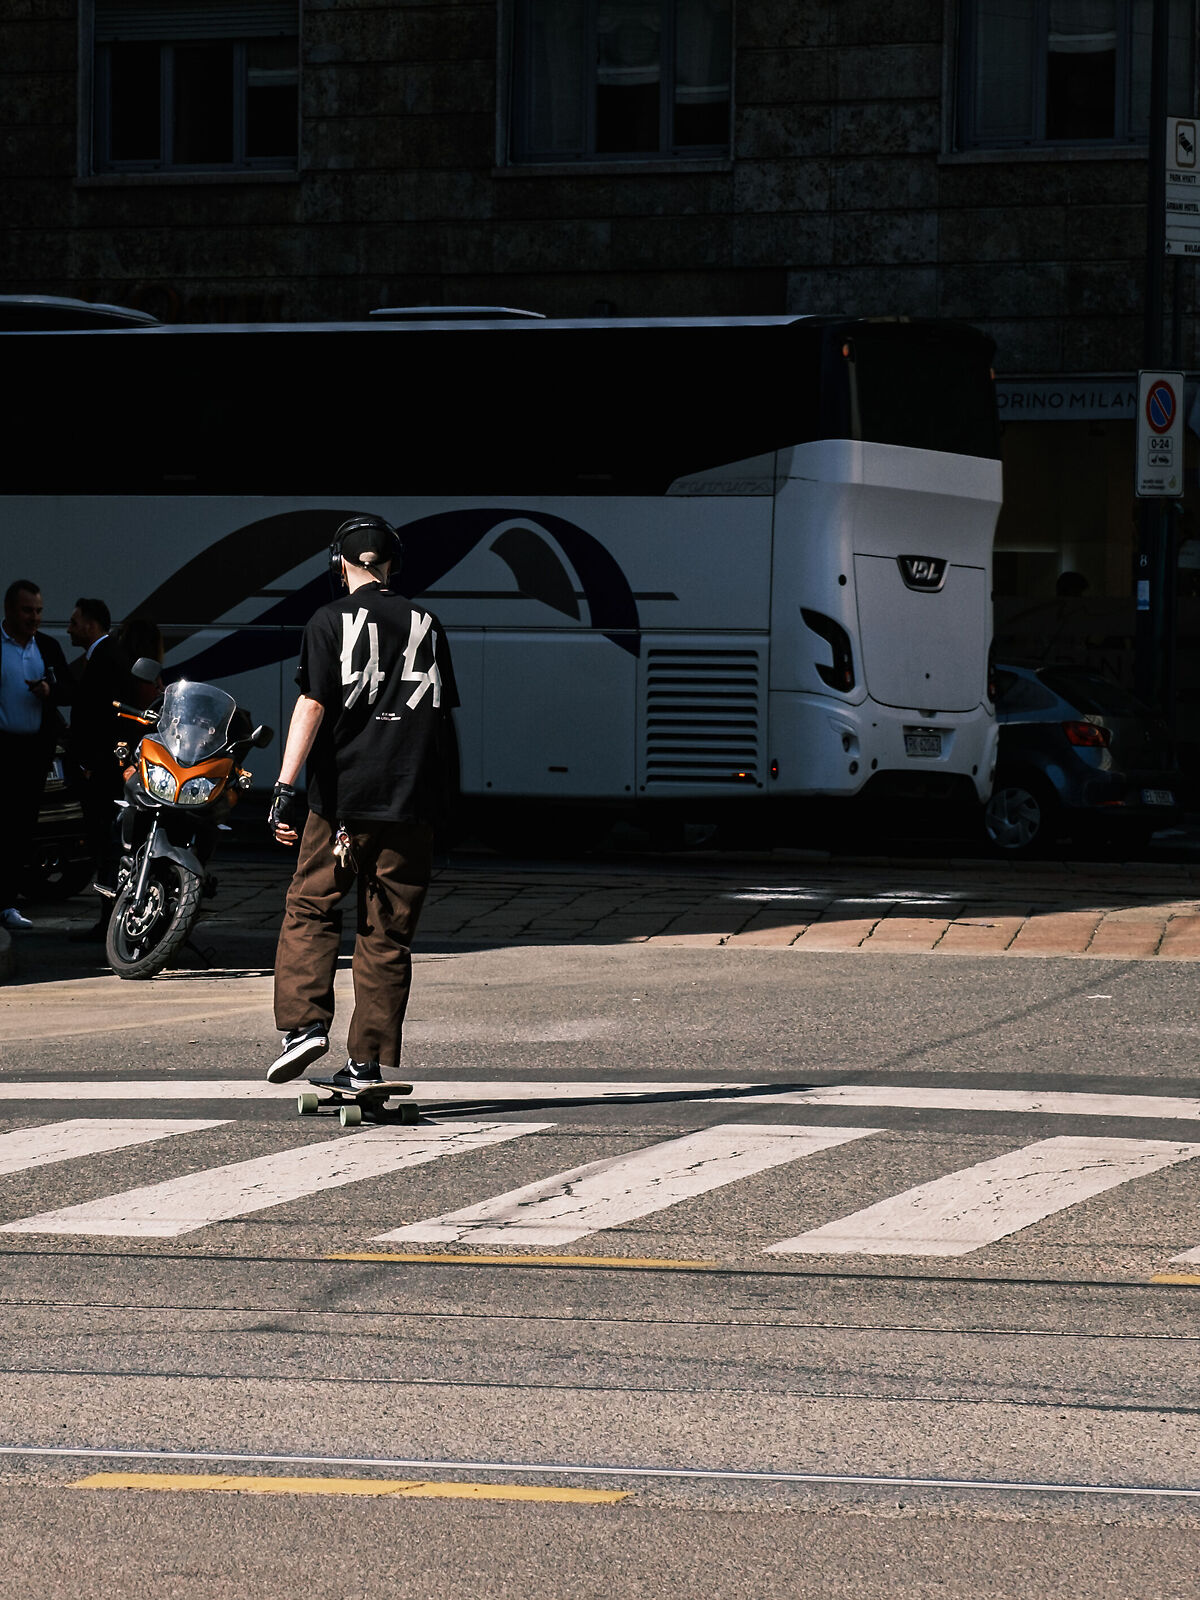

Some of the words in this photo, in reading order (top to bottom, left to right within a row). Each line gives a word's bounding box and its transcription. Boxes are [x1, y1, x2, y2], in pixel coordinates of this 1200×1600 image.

[1151, 439, 1170, 449] 0-24
[1139, 553, 1148, 567] 8
[904, 560, 939, 580] VDL
